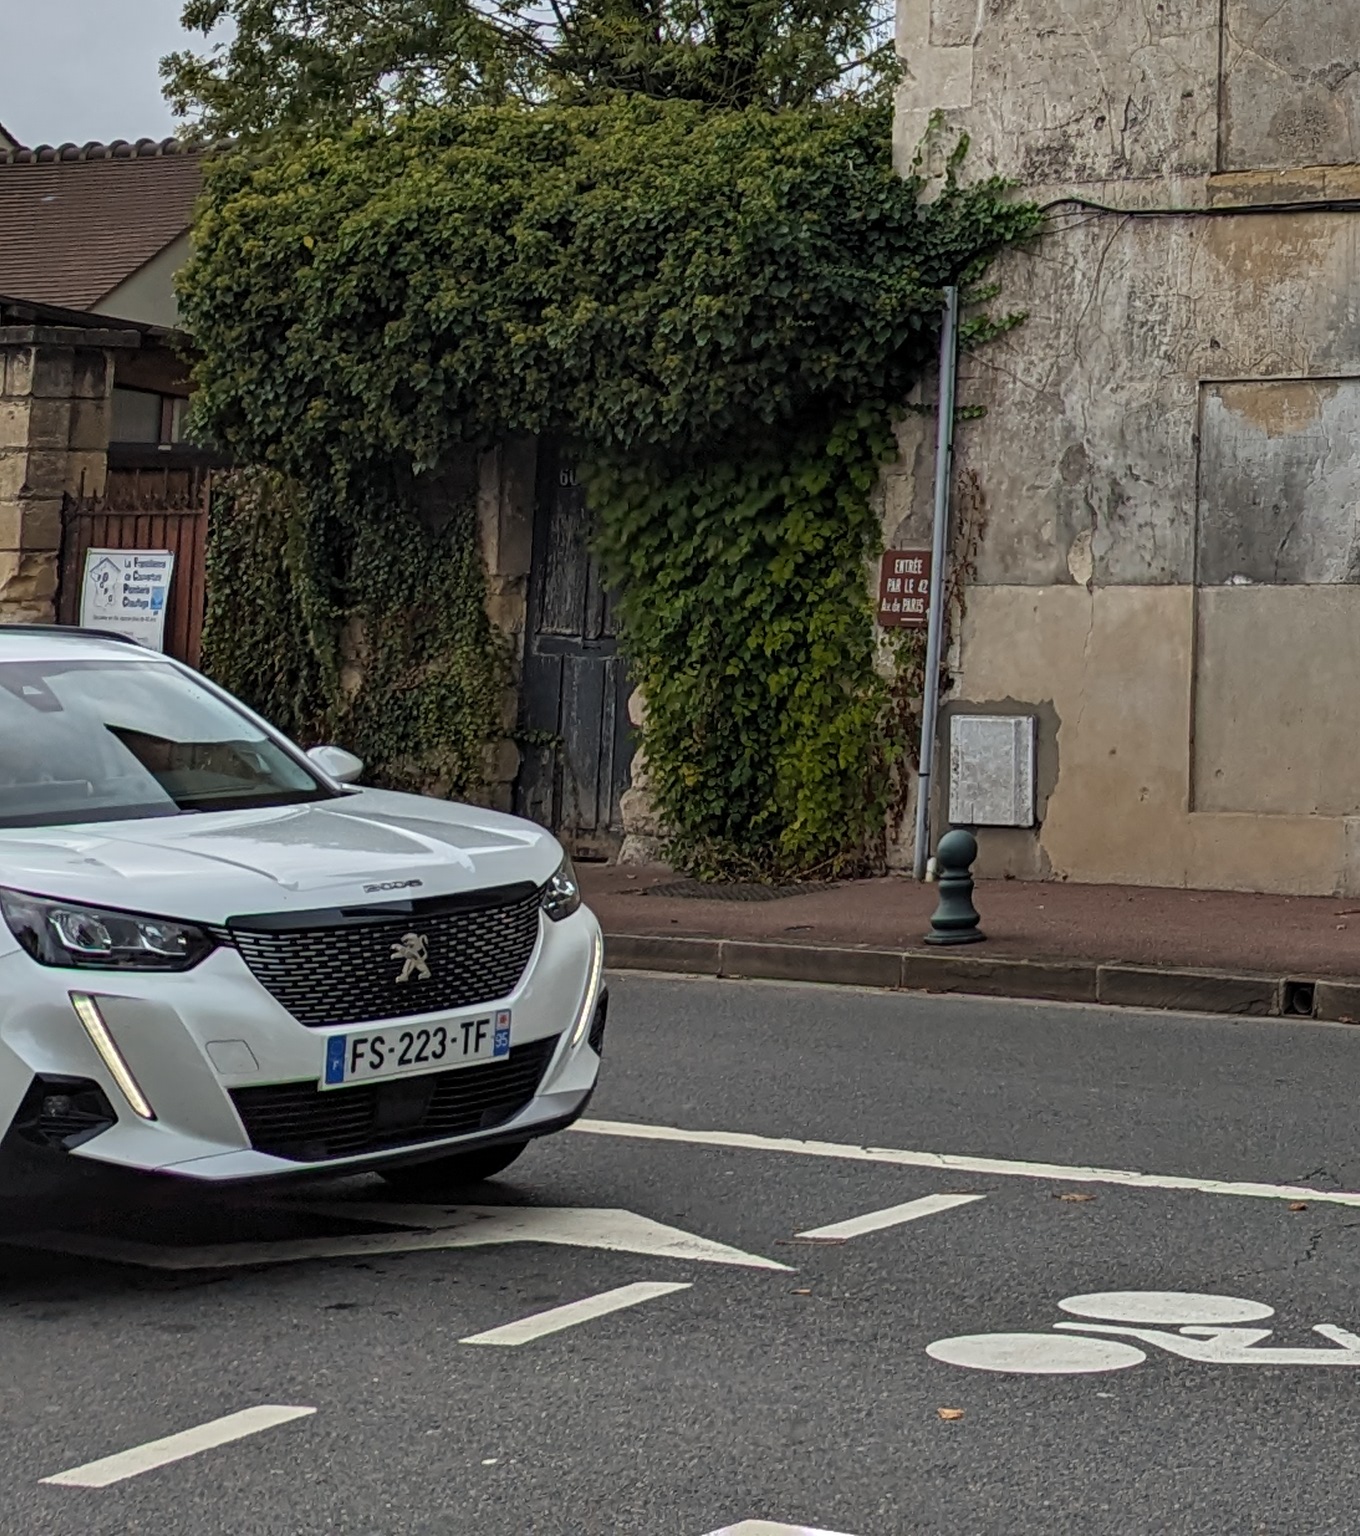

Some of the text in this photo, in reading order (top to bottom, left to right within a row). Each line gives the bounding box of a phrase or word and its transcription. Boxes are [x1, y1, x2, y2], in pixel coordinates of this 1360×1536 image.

[894, 557, 924, 574] ENTRÉE
[886, 577, 902, 593] PAR
[904, 578, 915, 594] LE
[901, 597, 924, 614] PARIS
[350, 1018, 491, 1074] FS-223-TF
[495, 1031, 509, 1049] 95
